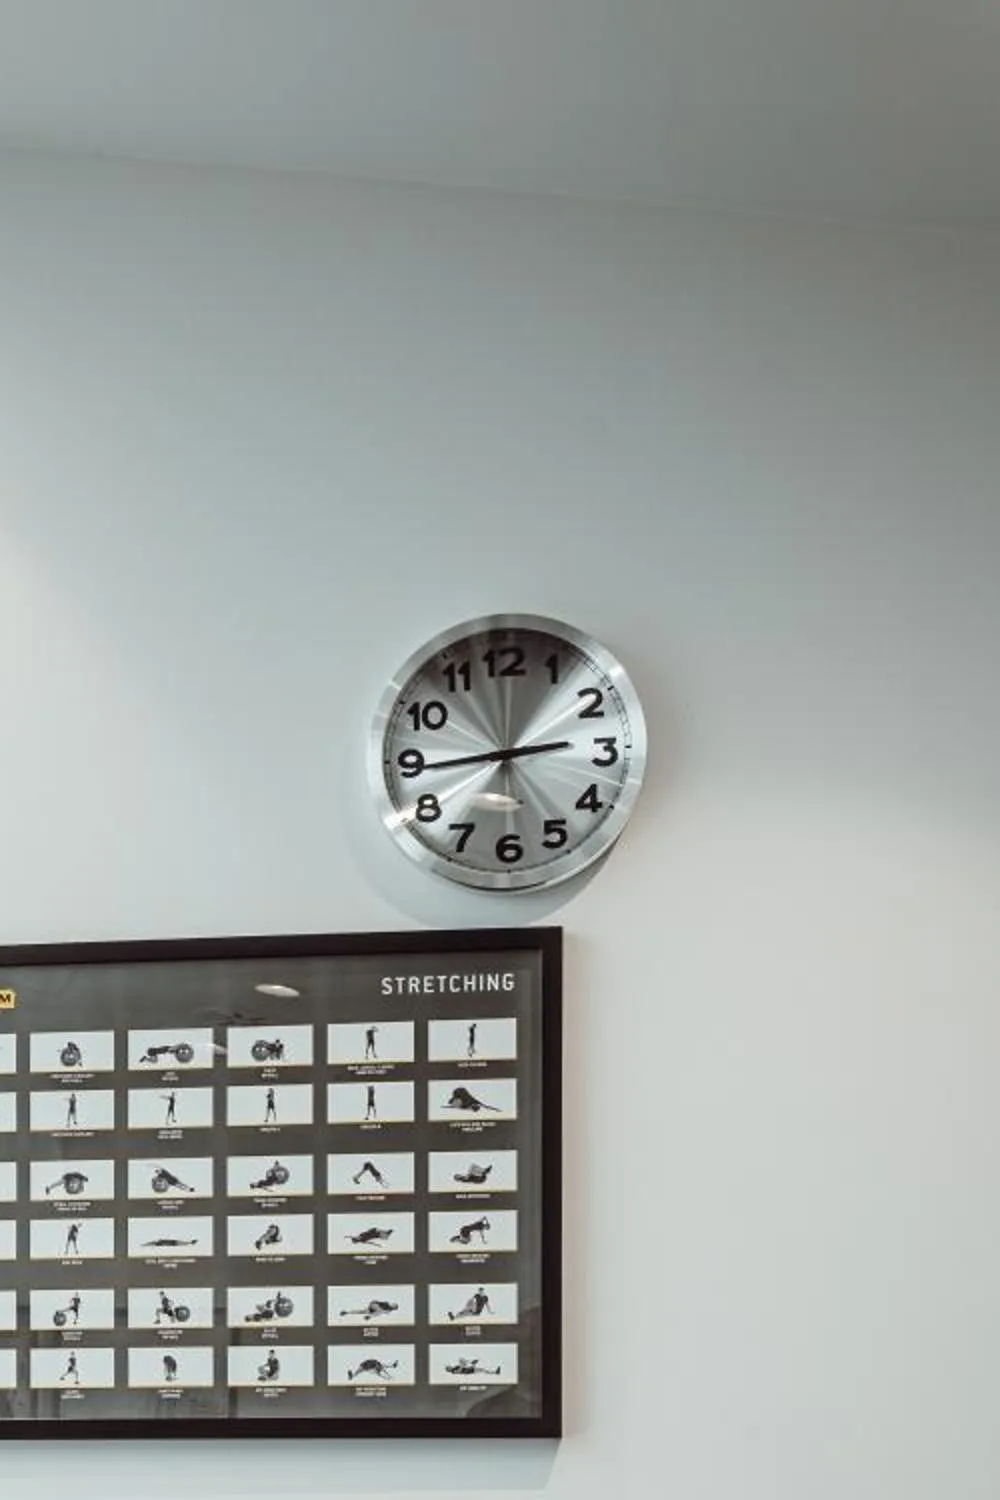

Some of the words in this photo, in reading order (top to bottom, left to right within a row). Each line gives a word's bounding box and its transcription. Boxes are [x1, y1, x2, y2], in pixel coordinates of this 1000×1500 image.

[442, 661, 472, 692] 11
[482, 648, 526, 678] 12
[544, 654, 559, 684] 1
[407, 701, 448, 731] 10
[577, 687, 605, 718] 2
[397, 748, 425, 778] 9
[591, 737, 619, 767] 3
[415, 793, 442, 823] 8
[575, 784, 603, 813] 4
[448, 822, 476, 853] 7
[541, 818, 569, 849] 5
[495, 835, 524, 863] 6
[380, 973, 516, 996] STRETCHING
